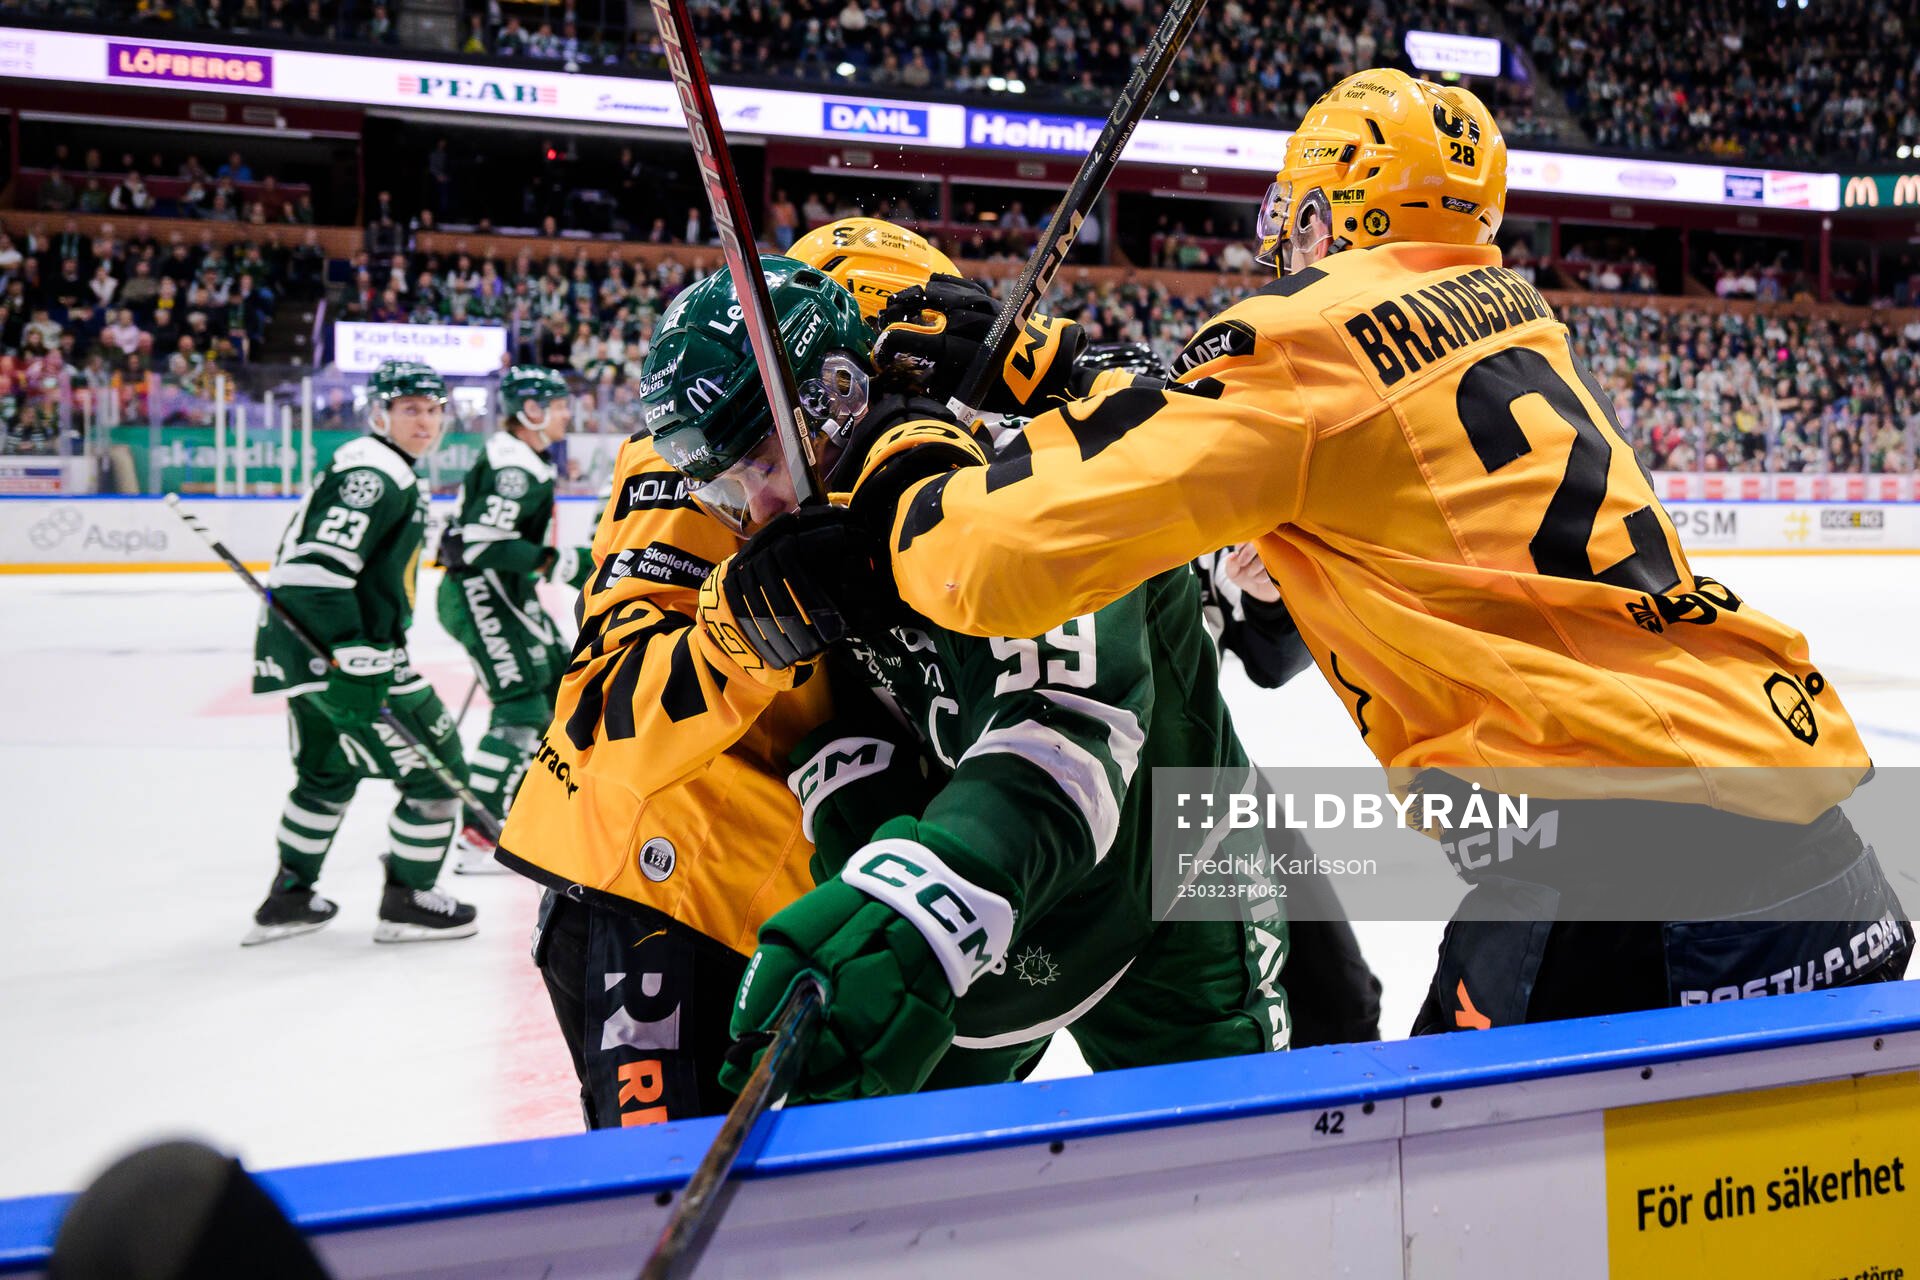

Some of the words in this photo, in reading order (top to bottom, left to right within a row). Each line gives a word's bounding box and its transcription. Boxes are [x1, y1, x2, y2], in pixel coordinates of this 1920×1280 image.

[417, 76, 538, 103] PEAB
[653, 0, 744, 263] JETSPEE
[830, 104, 921, 135] DAHL
[1303, 147, 1339, 158] CCM
[1449, 142, 1475, 167] 28
[1332, 190, 1355, 201] IMPACT
[1356, 190, 1365, 200] BY
[881, 239, 906, 250] Kraft
[1014, 209, 1085, 332] CCM
[859, 285, 892, 298] CC
[794, 313, 822, 358] CCM
[645, 400, 675, 424] CCM
[1456, 334, 1681, 595] 2
[316, 506, 370, 550] 23
[480, 495, 520, 531] 32
[82, 525, 169, 554] Aspia
[637, 560, 672, 580] Kraft
[643, 547, 711, 579] Skellefteå
[989, 612, 1097, 698] 59
[798, 743, 878, 807] CM
[859, 852, 993, 979] CCM
[1314, 1110, 1345, 1135] 42
[1637, 1184, 1693, 1232] För
[1703, 1176, 1756, 1222] din
[1766, 1156, 1905, 1213] säkerhet
